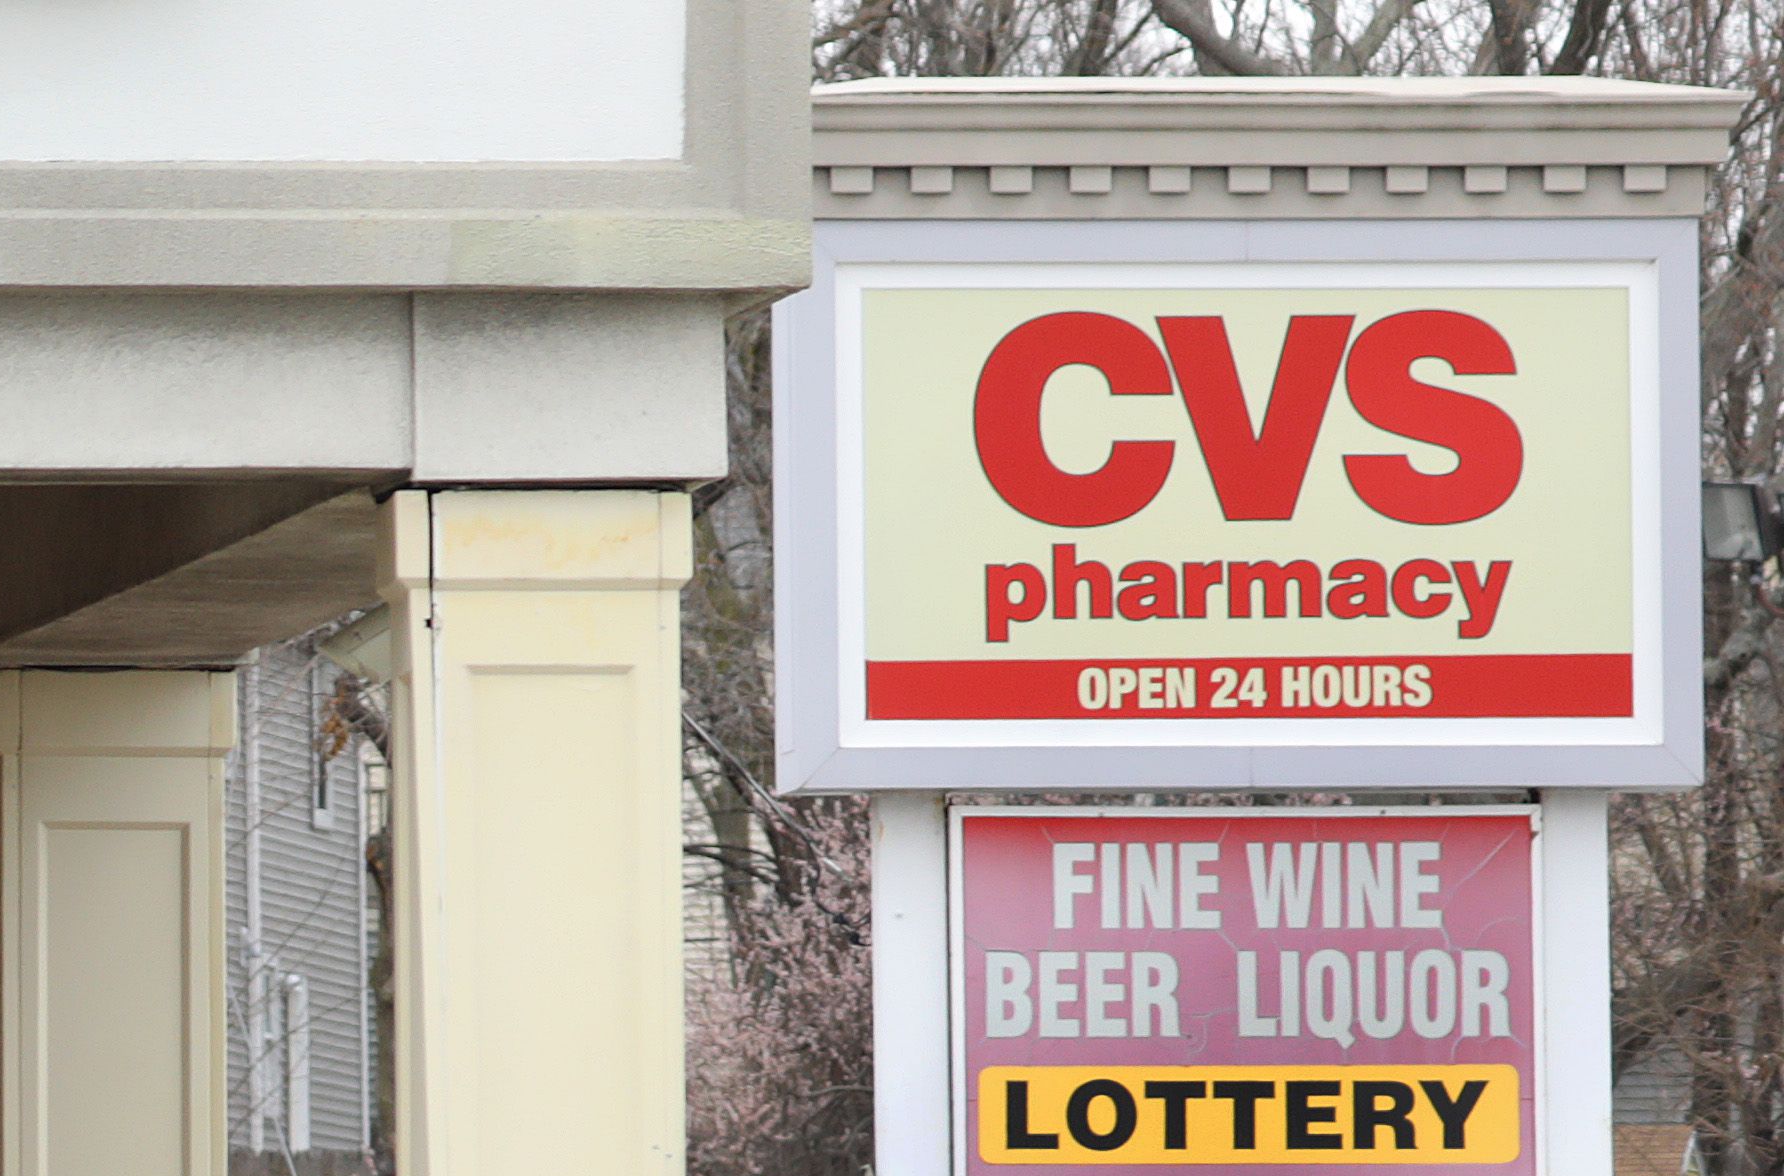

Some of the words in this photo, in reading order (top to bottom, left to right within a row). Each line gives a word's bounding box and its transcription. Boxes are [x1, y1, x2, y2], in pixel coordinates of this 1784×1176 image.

[973, 309, 1523, 527] CVS
[984, 543, 1512, 642] pharmacy
[1077, 667, 1196, 709] OPEN
[1210, 667, 1268, 708] 24
[1281, 664, 1433, 708] HOURS
[1052, 842, 1222, 930] FINE
[1245, 841, 1444, 929] WINE
[985, 950, 1182, 1038] BEER
[1237, 948, 1513, 1050] LIQUOR
[1004, 1078, 1490, 1152] LOTTERY
